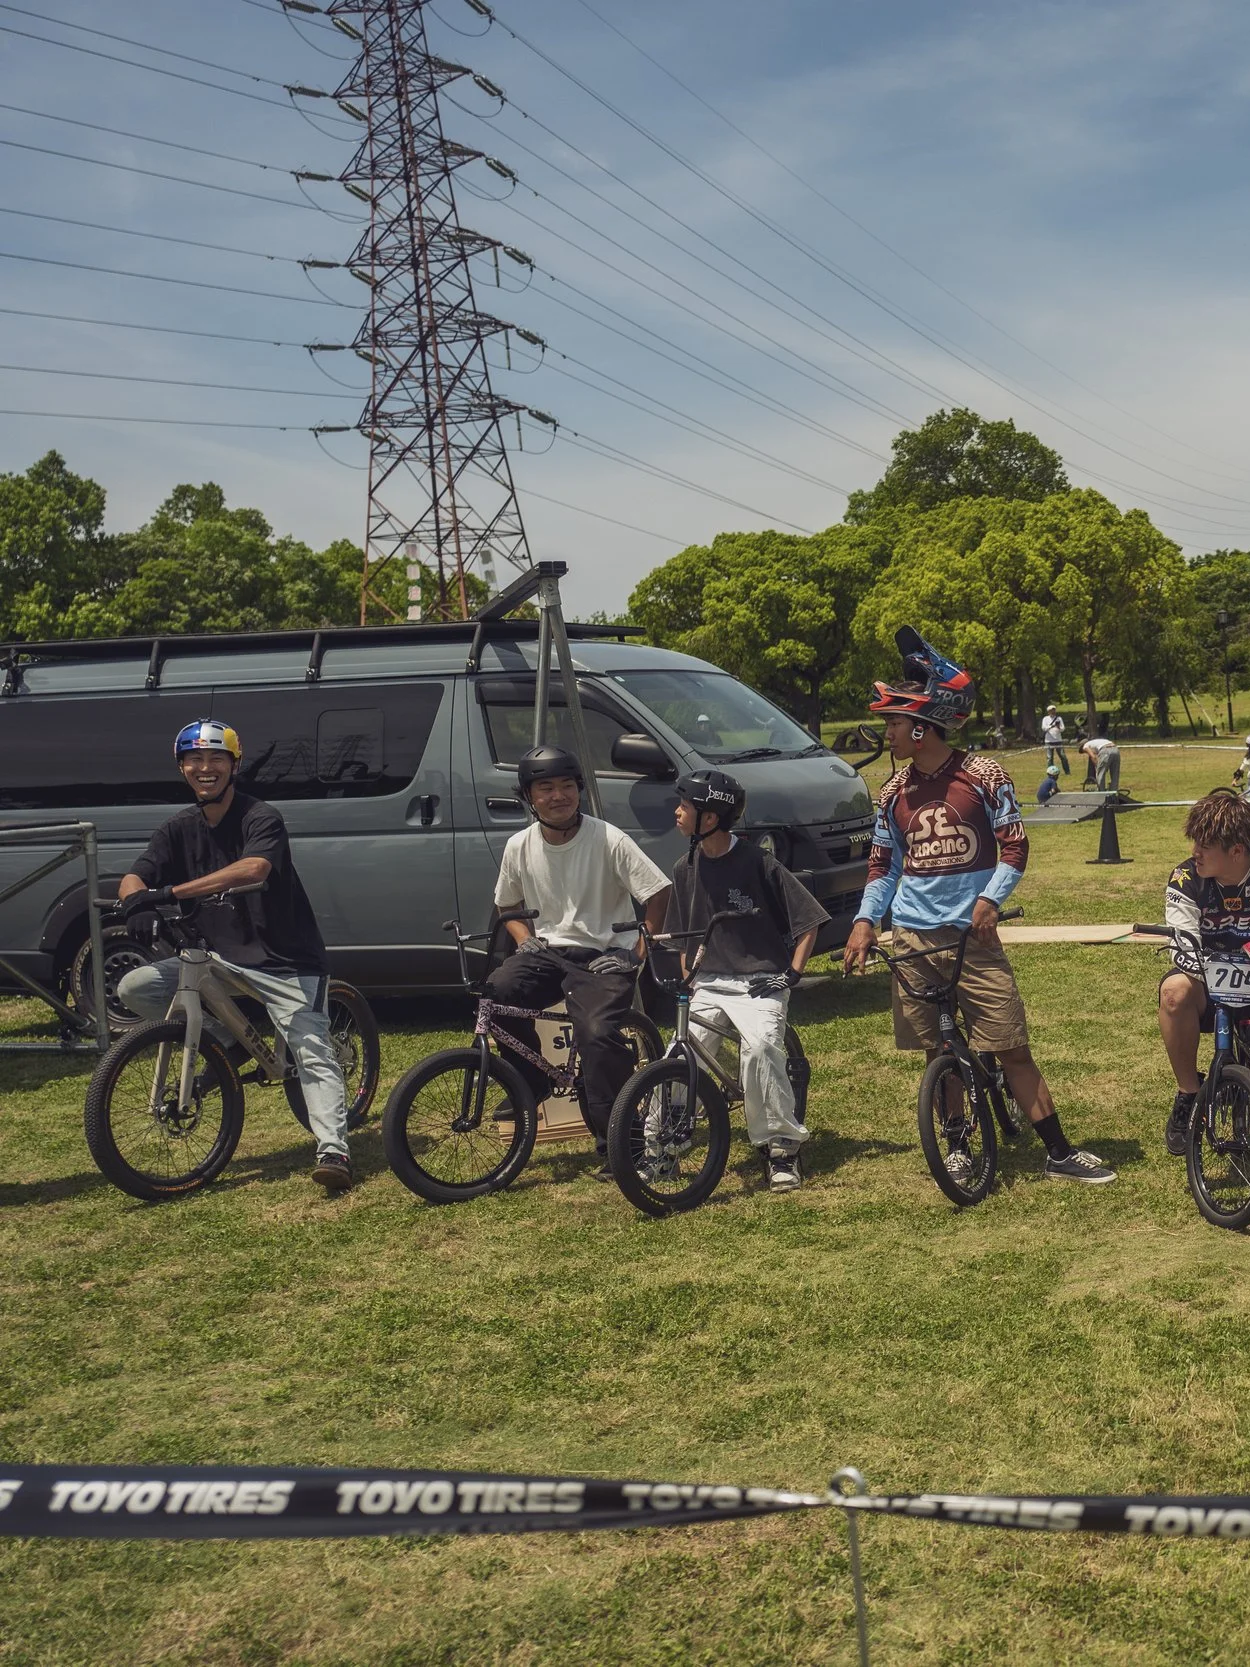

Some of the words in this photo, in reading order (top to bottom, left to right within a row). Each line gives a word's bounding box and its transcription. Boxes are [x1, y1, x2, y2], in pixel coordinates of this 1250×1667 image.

[914, 806, 957, 841] SE
[911, 837, 967, 858] RACING
[48, 1480, 167, 1514] TOYO
[164, 1480, 296, 1514] TIRES
[336, 1479, 456, 1513] TOYO
[457, 1480, 585, 1514] TIRES
[622, 1483, 742, 1511] TOYO
